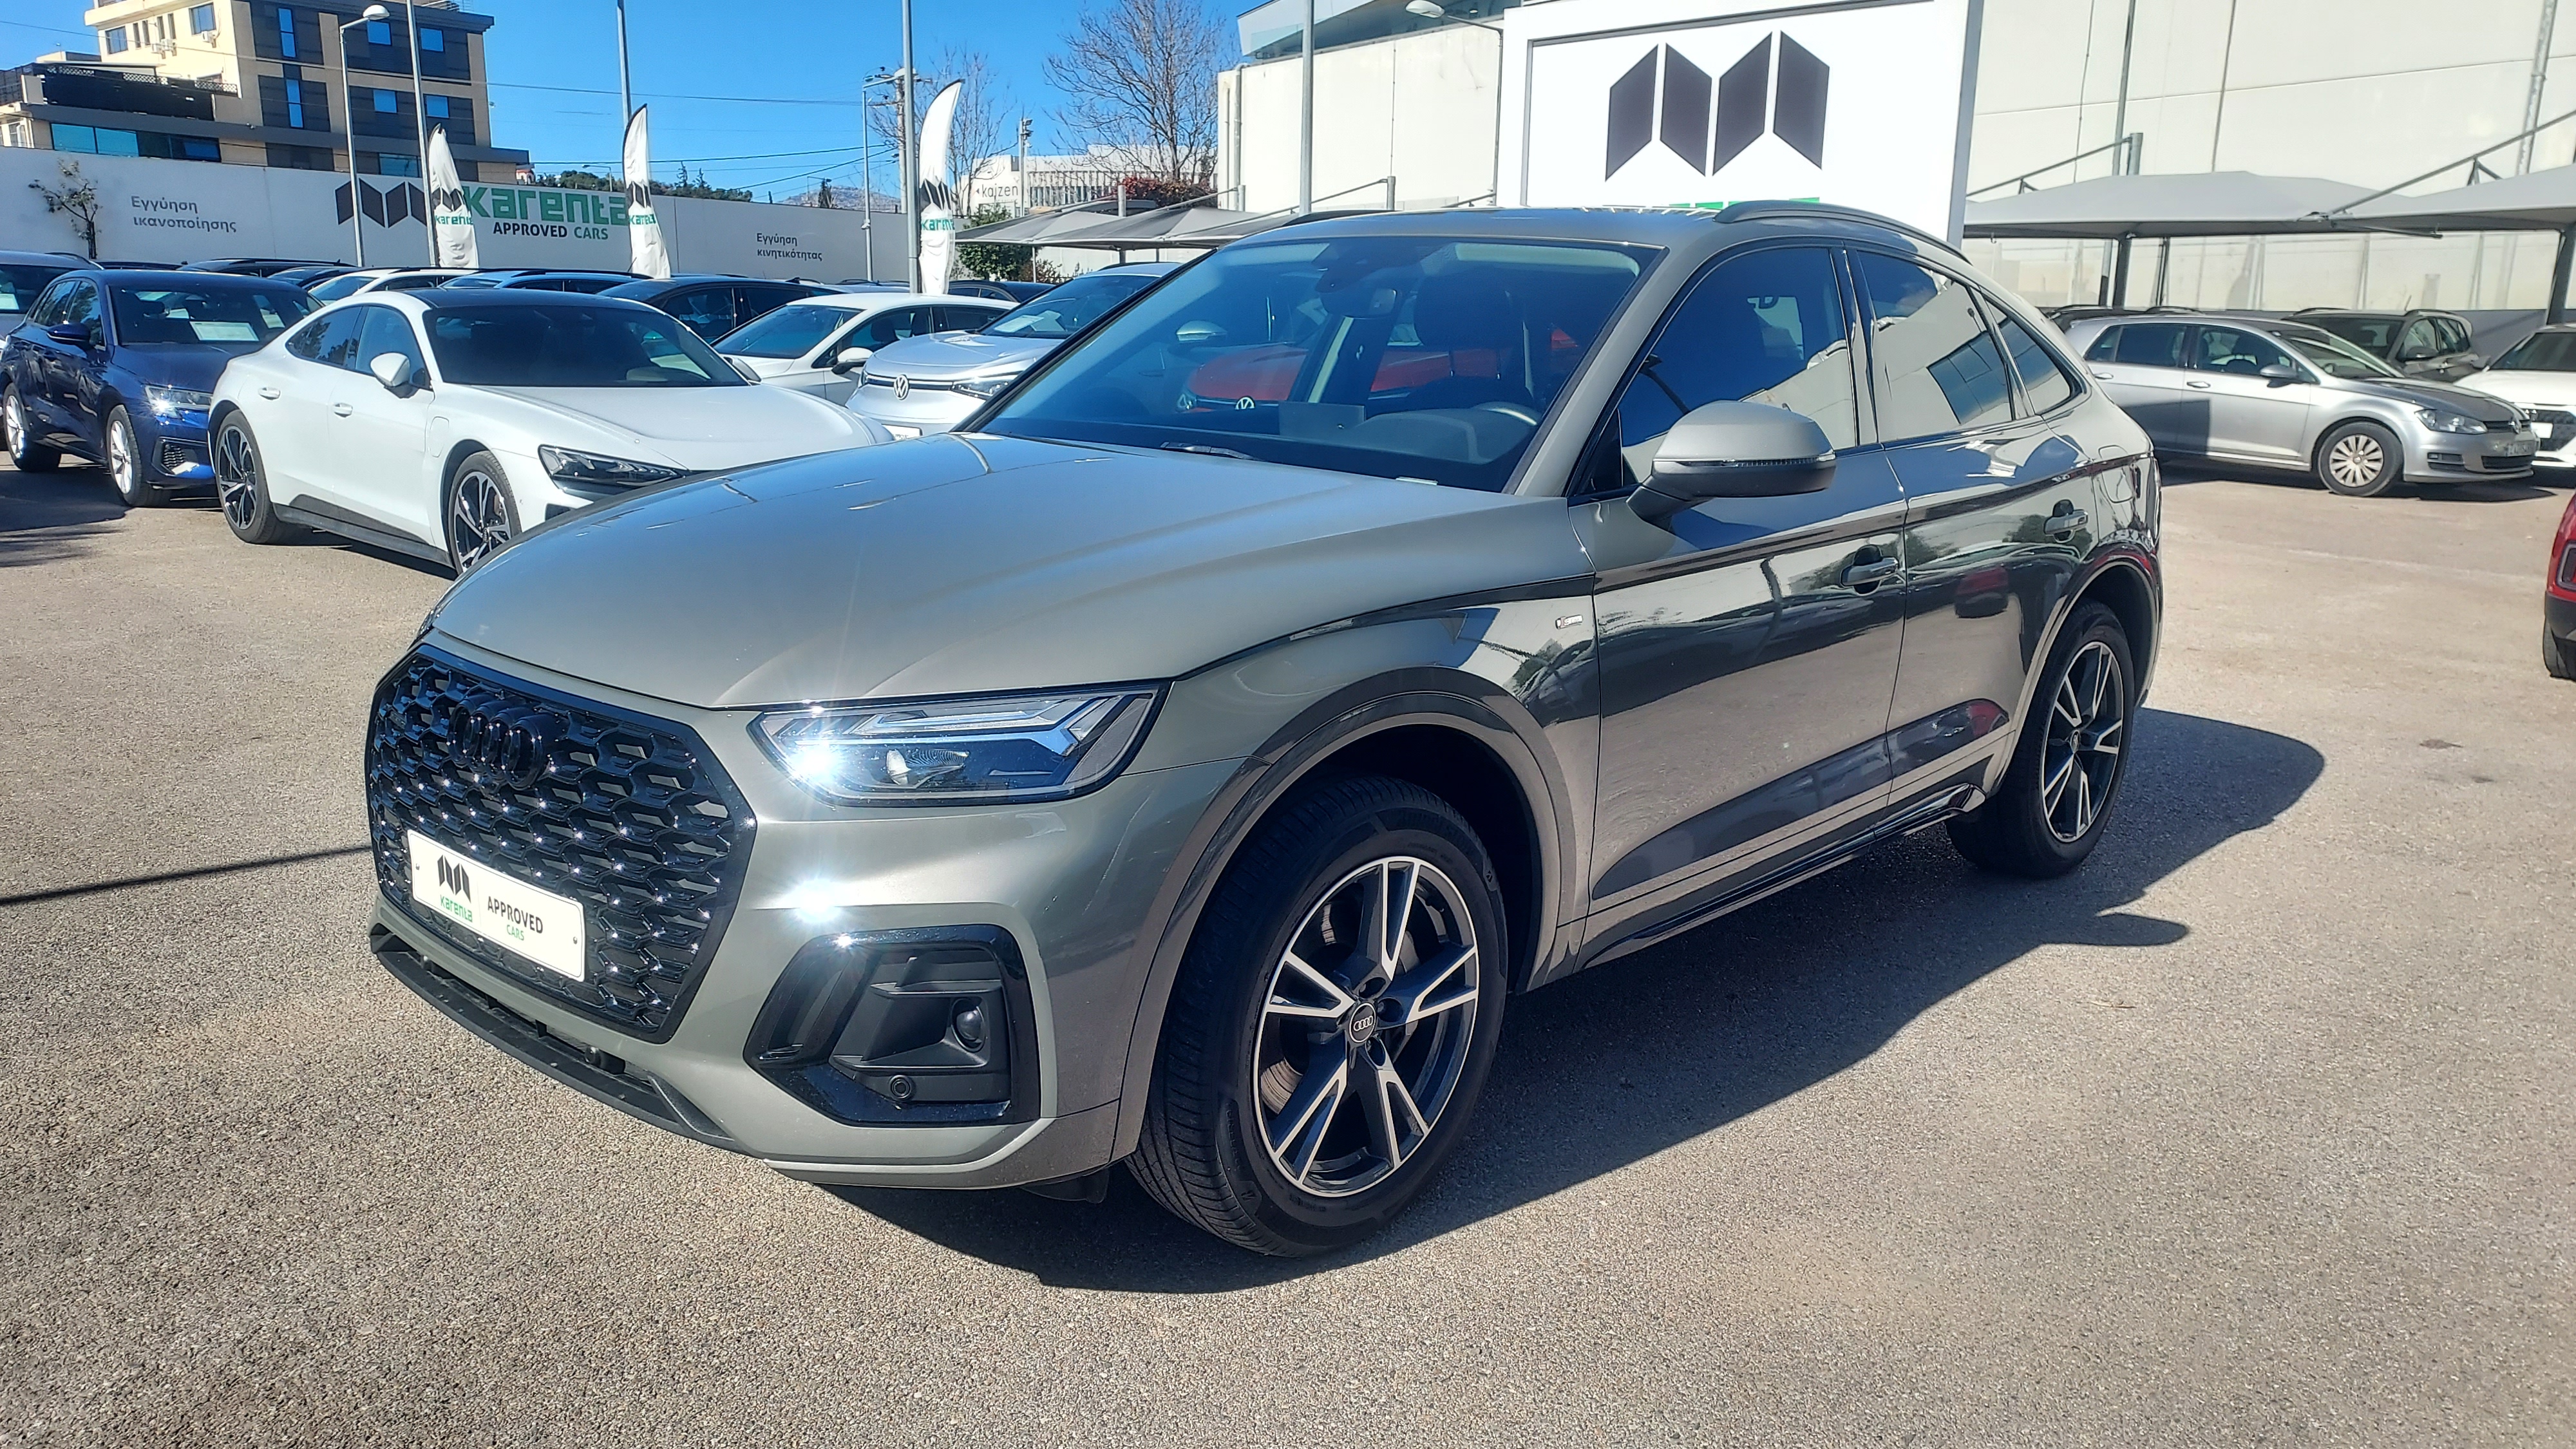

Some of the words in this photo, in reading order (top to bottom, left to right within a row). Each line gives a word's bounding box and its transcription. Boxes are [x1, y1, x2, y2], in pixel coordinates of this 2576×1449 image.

[981, 184, 1018, 198] kaizen
[131, 195, 198, 214] Εγγύηση
[461, 185, 627, 225] karenta
[133, 216, 237, 233] ικανοποίησης
[493, 222, 567, 238] APPROVED
[574, 226, 609, 240] CARS
[756, 232, 798, 247] Εγγύηση
[757, 248, 823, 262] κινητικότητας
[440, 895, 473, 923] karenta
[488, 896, 544, 934] APPROVED
[506, 924, 525, 941] CARS
